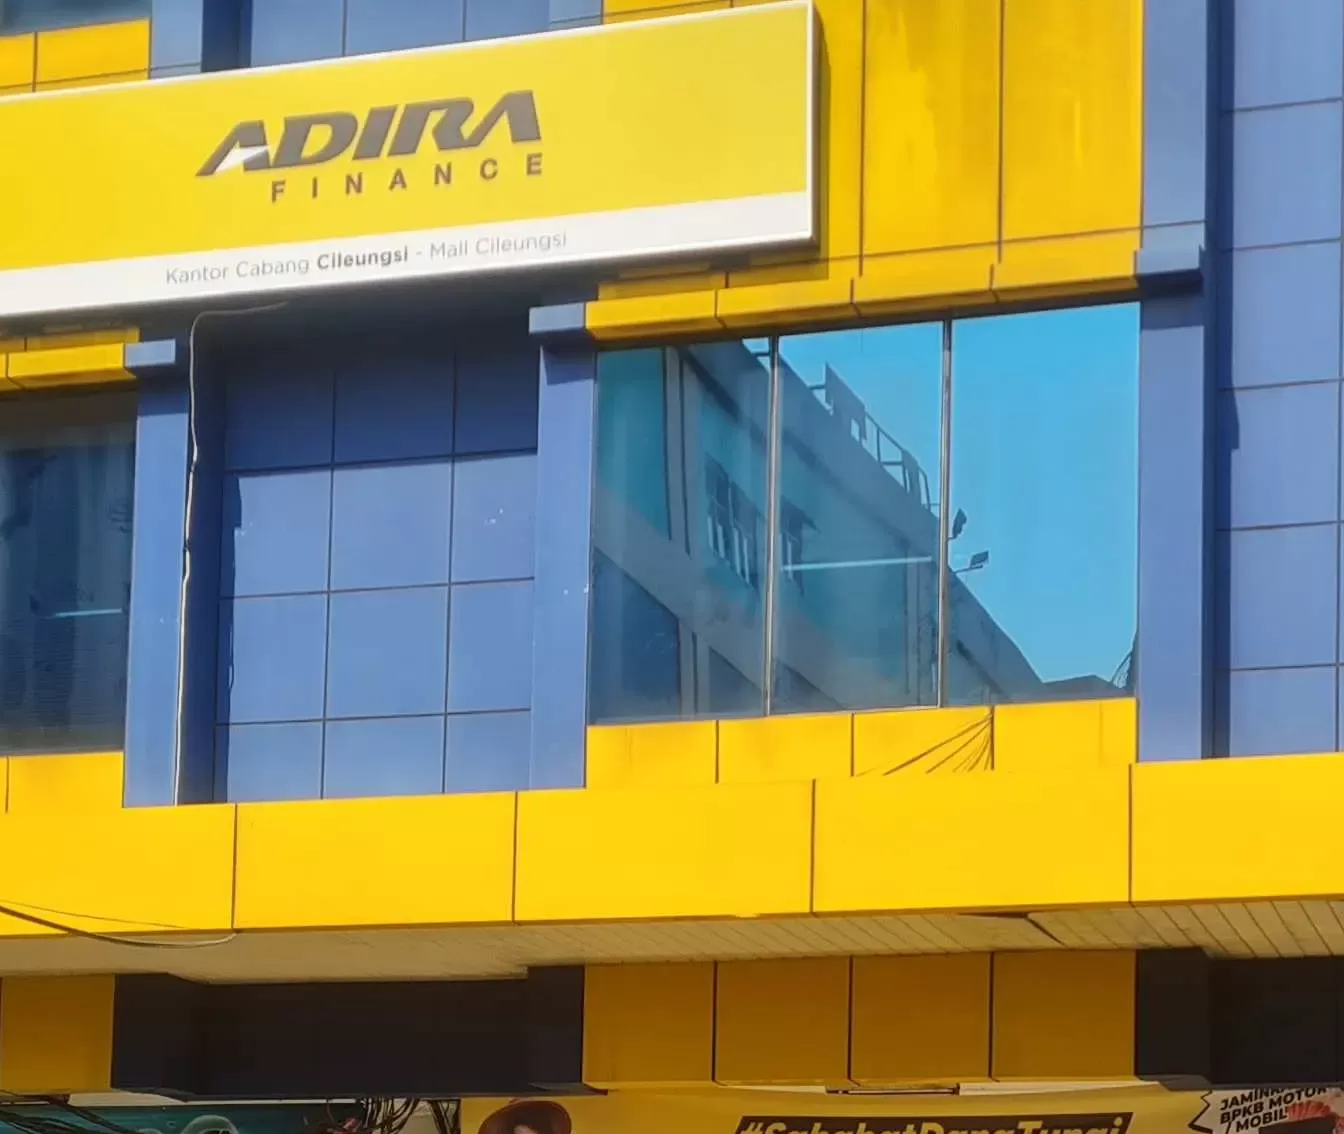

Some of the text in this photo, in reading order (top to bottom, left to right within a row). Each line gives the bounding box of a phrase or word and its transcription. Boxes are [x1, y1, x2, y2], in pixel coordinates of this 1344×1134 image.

[194, 89, 543, 177] ADIRA
[270, 152, 544, 203] FINANCE
[165, 263, 229, 285] Kantor
[235, 256, 310, 279] Cabang
[316, 246, 409, 271] Cileungsi
[430, 240, 468, 261] Mall
[475, 231, 568, 256] Cileungsi
[1220, 1101, 1264, 1124] BPKB
[1236, 1108, 1288, 1133] MOBIL
